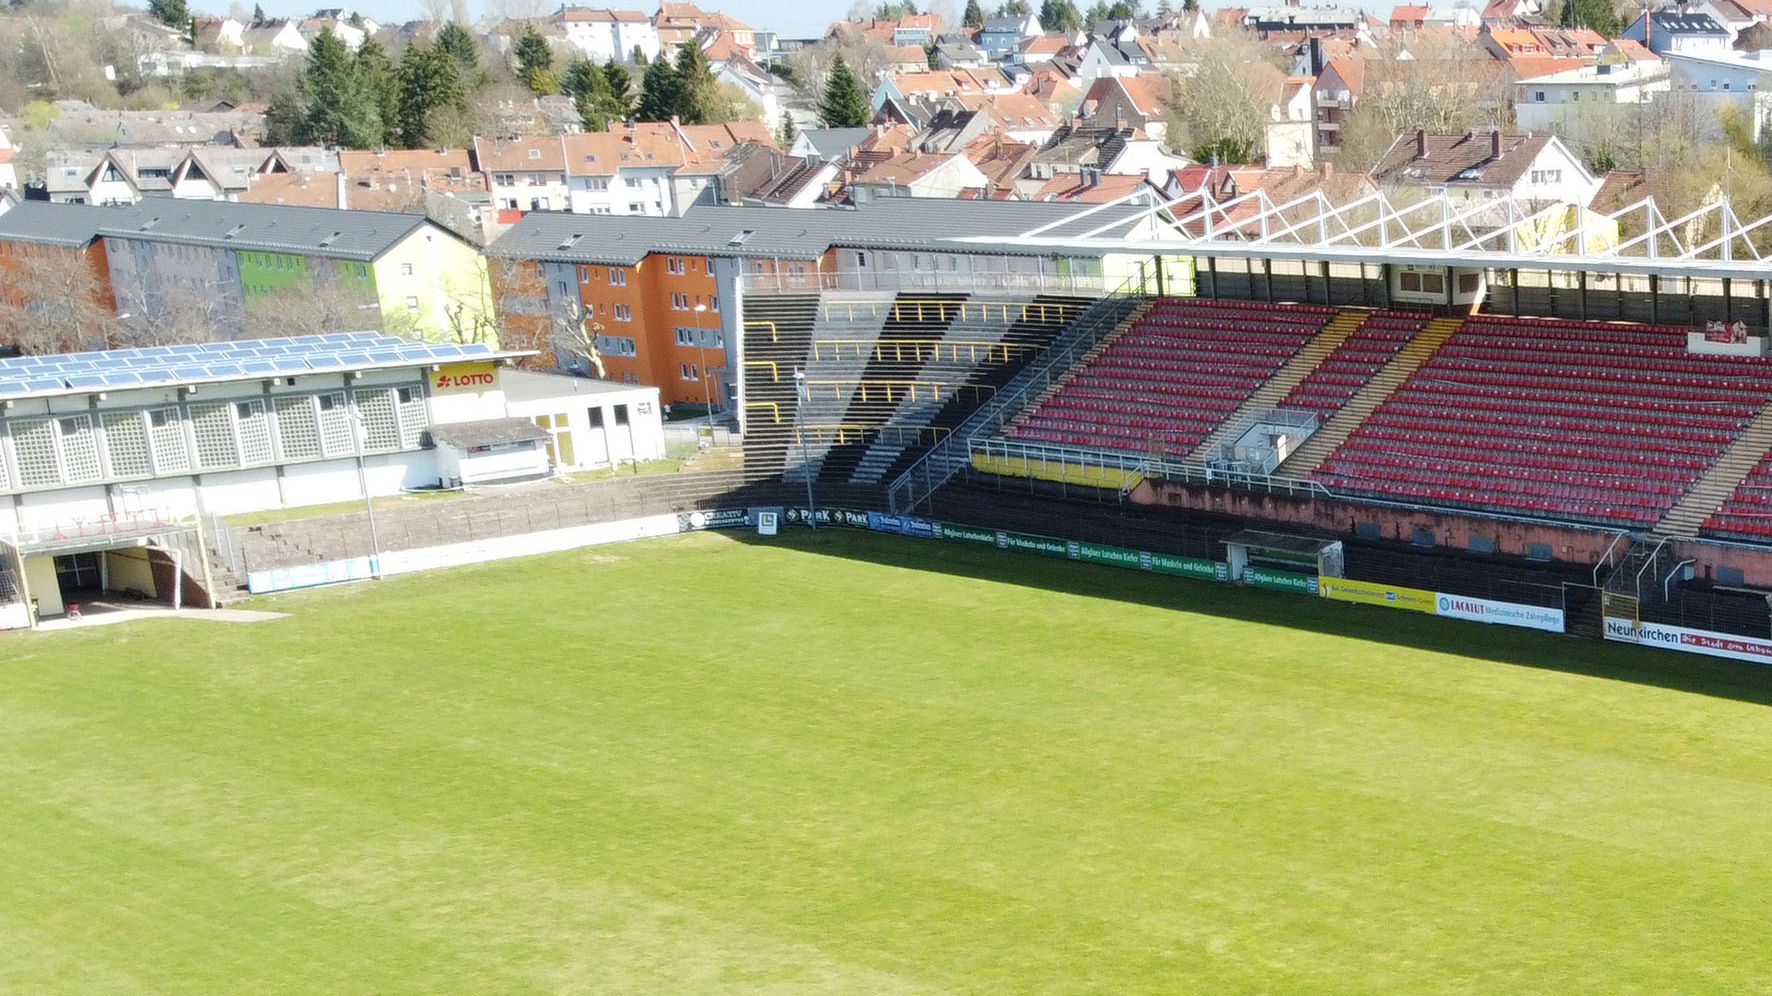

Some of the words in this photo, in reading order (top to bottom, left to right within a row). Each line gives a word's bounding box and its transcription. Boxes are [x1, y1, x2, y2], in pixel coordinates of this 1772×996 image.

[454, 373, 494, 387] LOTTO
[845, 512, 868, 523] PARK
[1450, 600, 1485, 615] LACALUT
[1607, 622, 1678, 643] Neunkirchen
